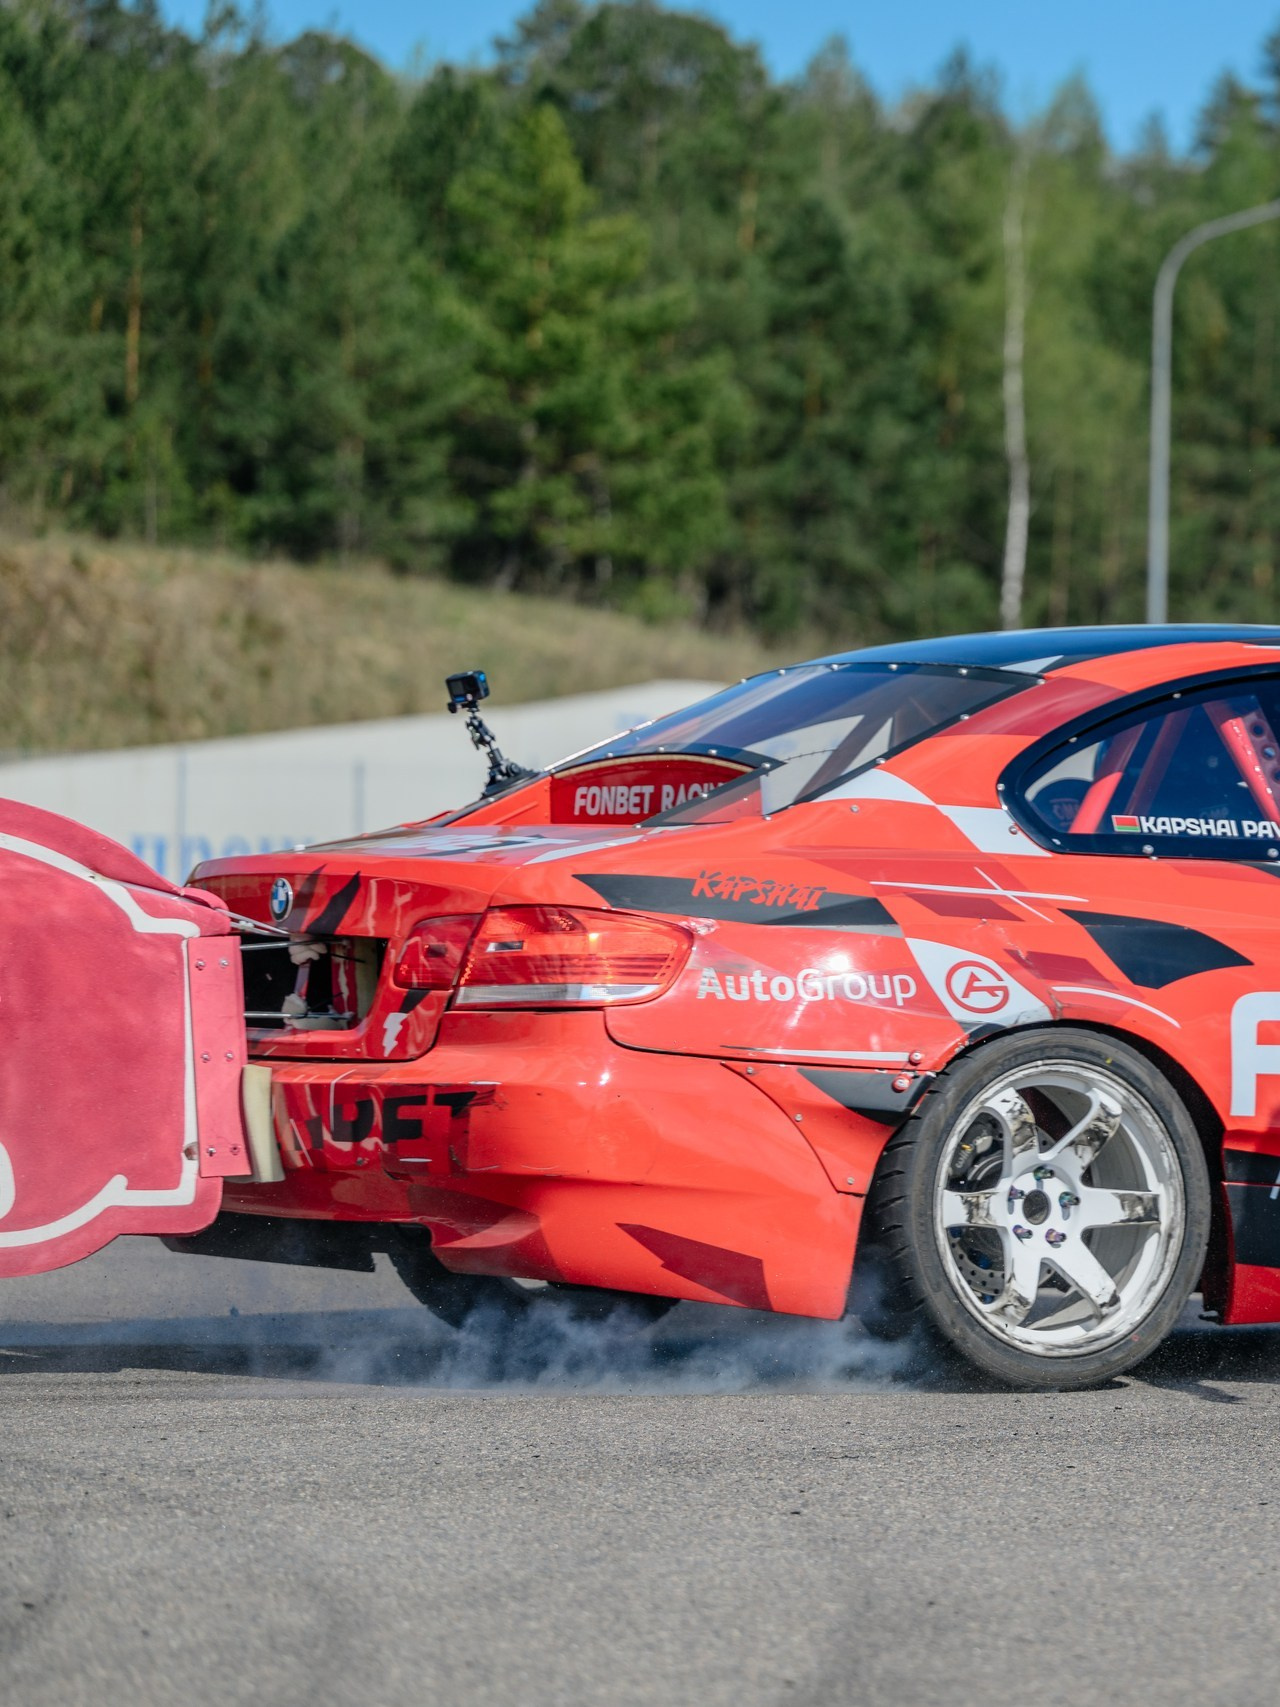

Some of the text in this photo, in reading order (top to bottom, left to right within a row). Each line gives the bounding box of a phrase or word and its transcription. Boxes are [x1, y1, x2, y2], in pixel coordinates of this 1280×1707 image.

[574, 785, 655, 816] FONBET
[1139, 816, 1239, 838] KAPSHAI
[691, 869, 828, 911] KAPSHAI
[696, 967, 917, 1006] AutoGroup
